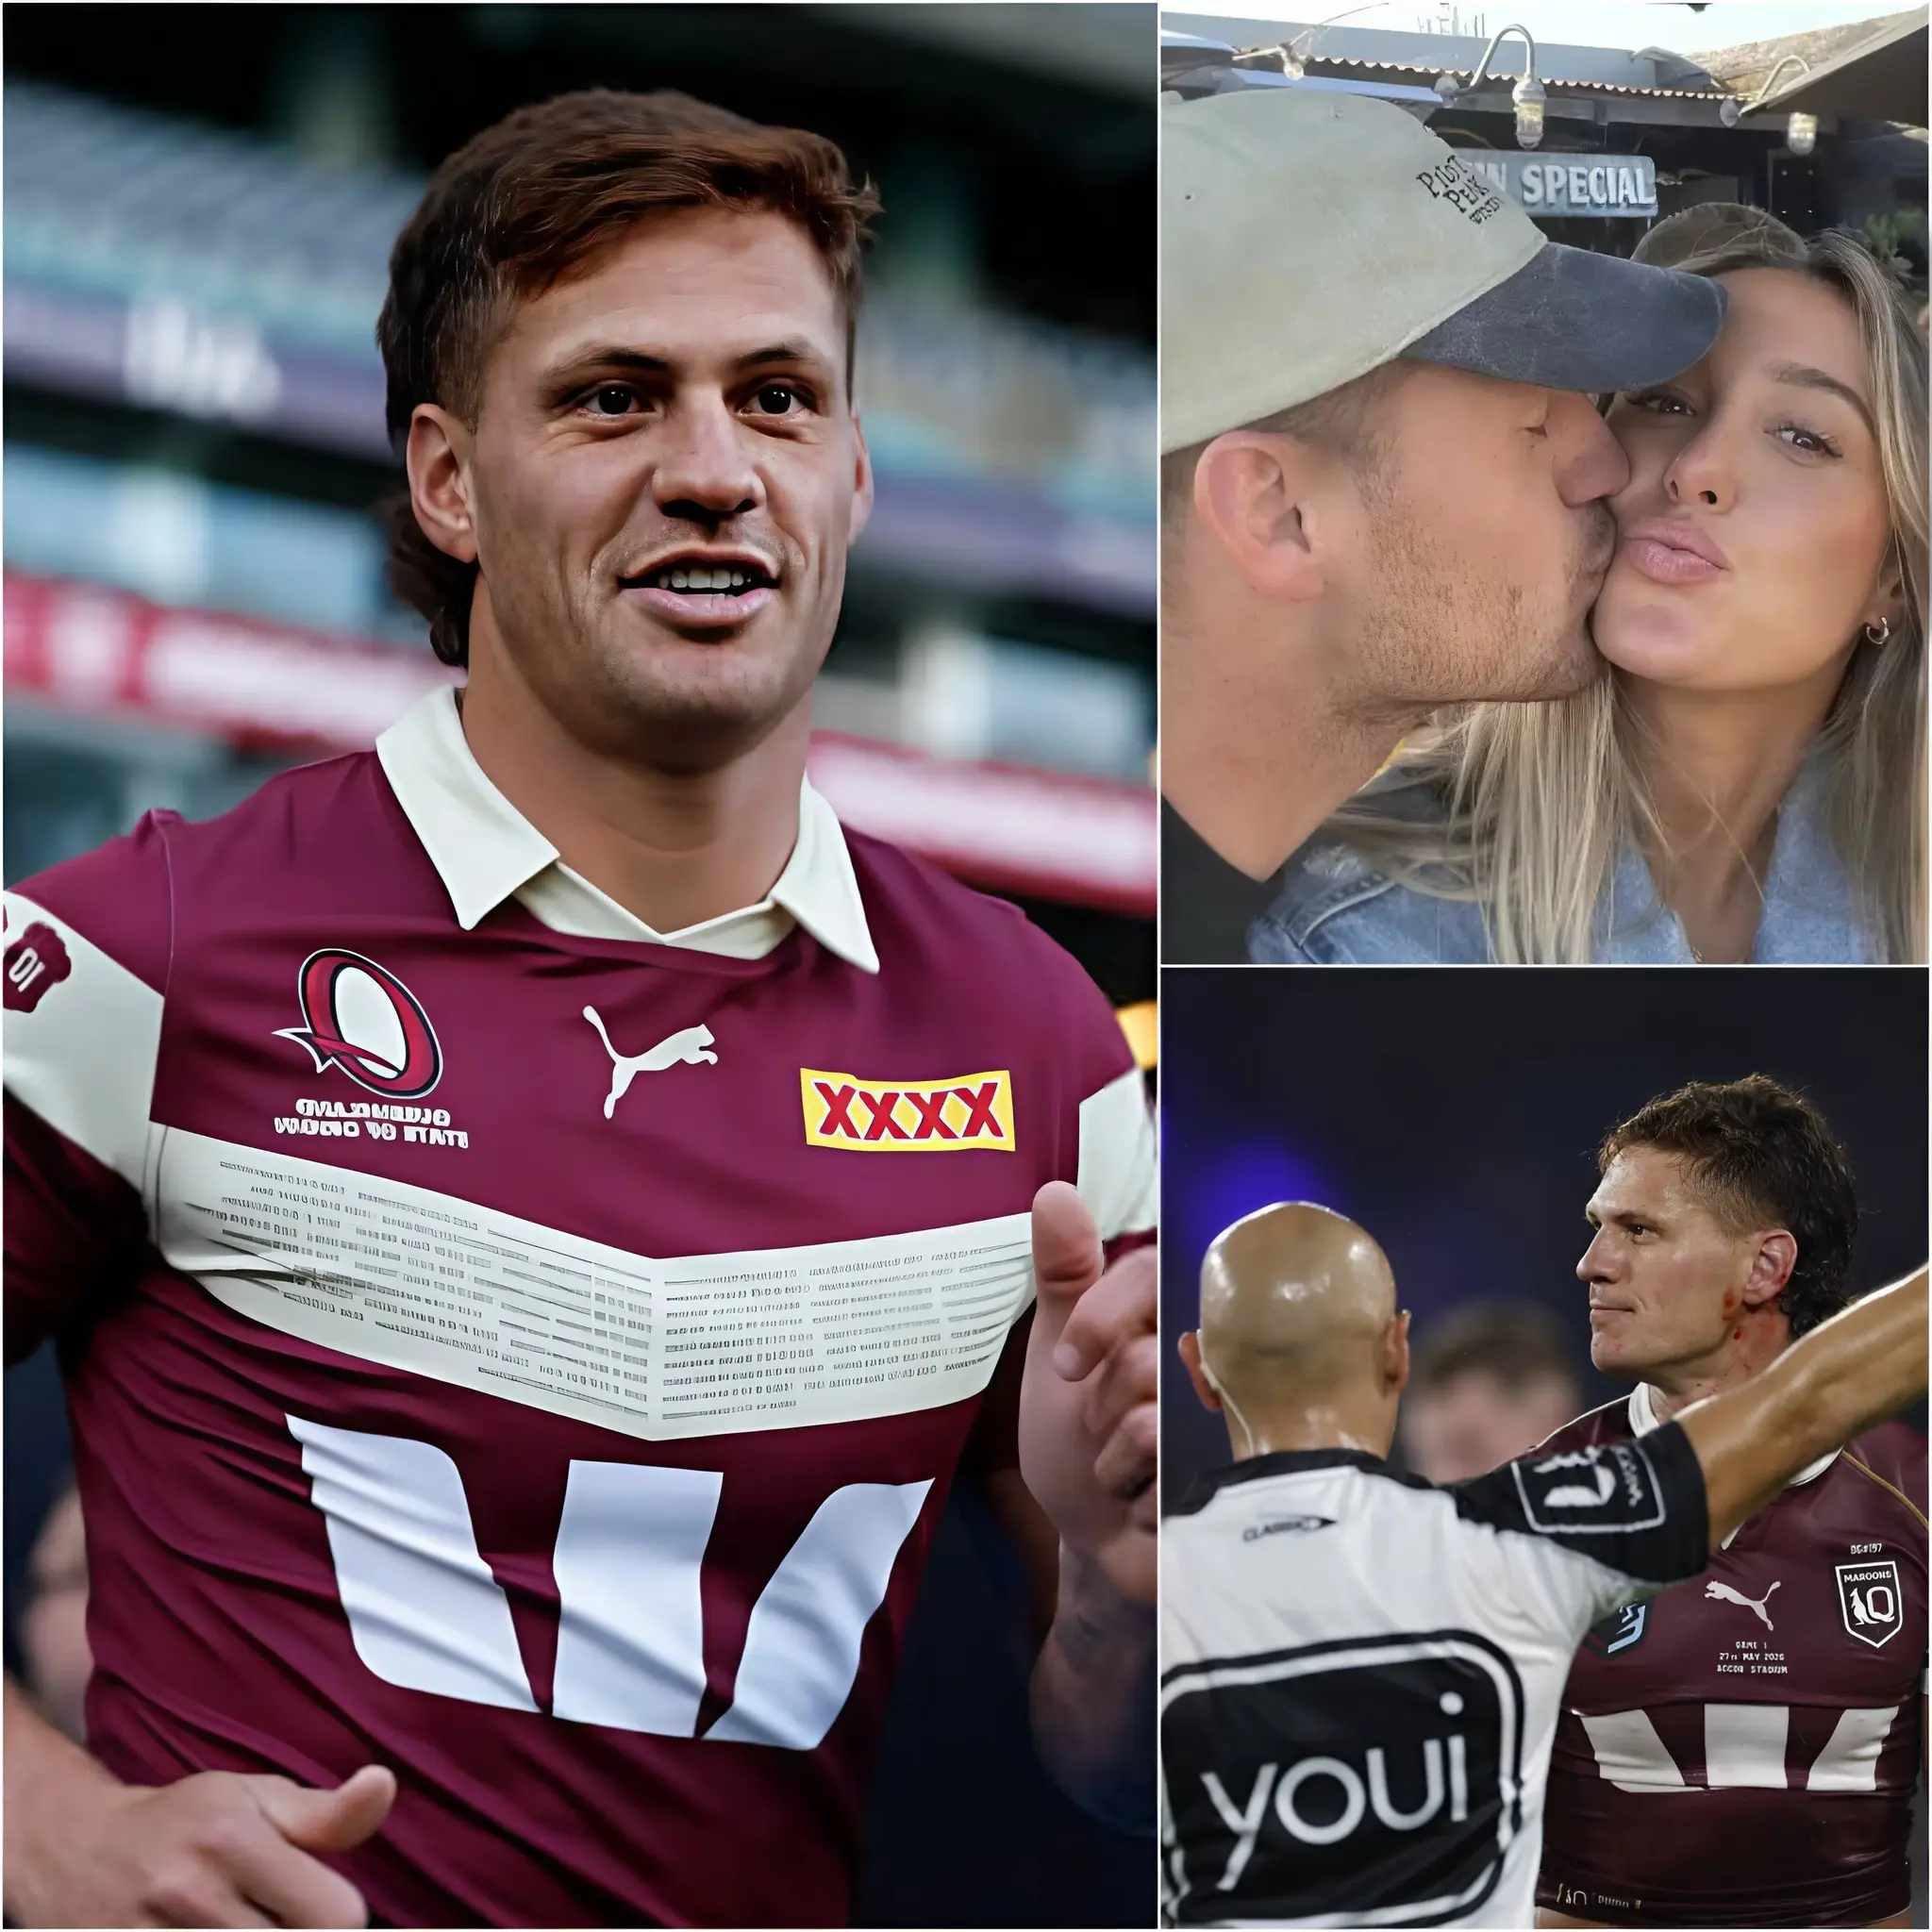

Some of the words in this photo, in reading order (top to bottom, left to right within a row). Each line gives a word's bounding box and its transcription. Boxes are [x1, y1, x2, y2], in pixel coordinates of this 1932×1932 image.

[1521, 164, 1656, 205] SPECIAL
[813, 1081, 1005, 1141] XXXX
[1843, 1571, 1892, 1583] MAROONS
[1200, 1691, 1469, 1890] youi
